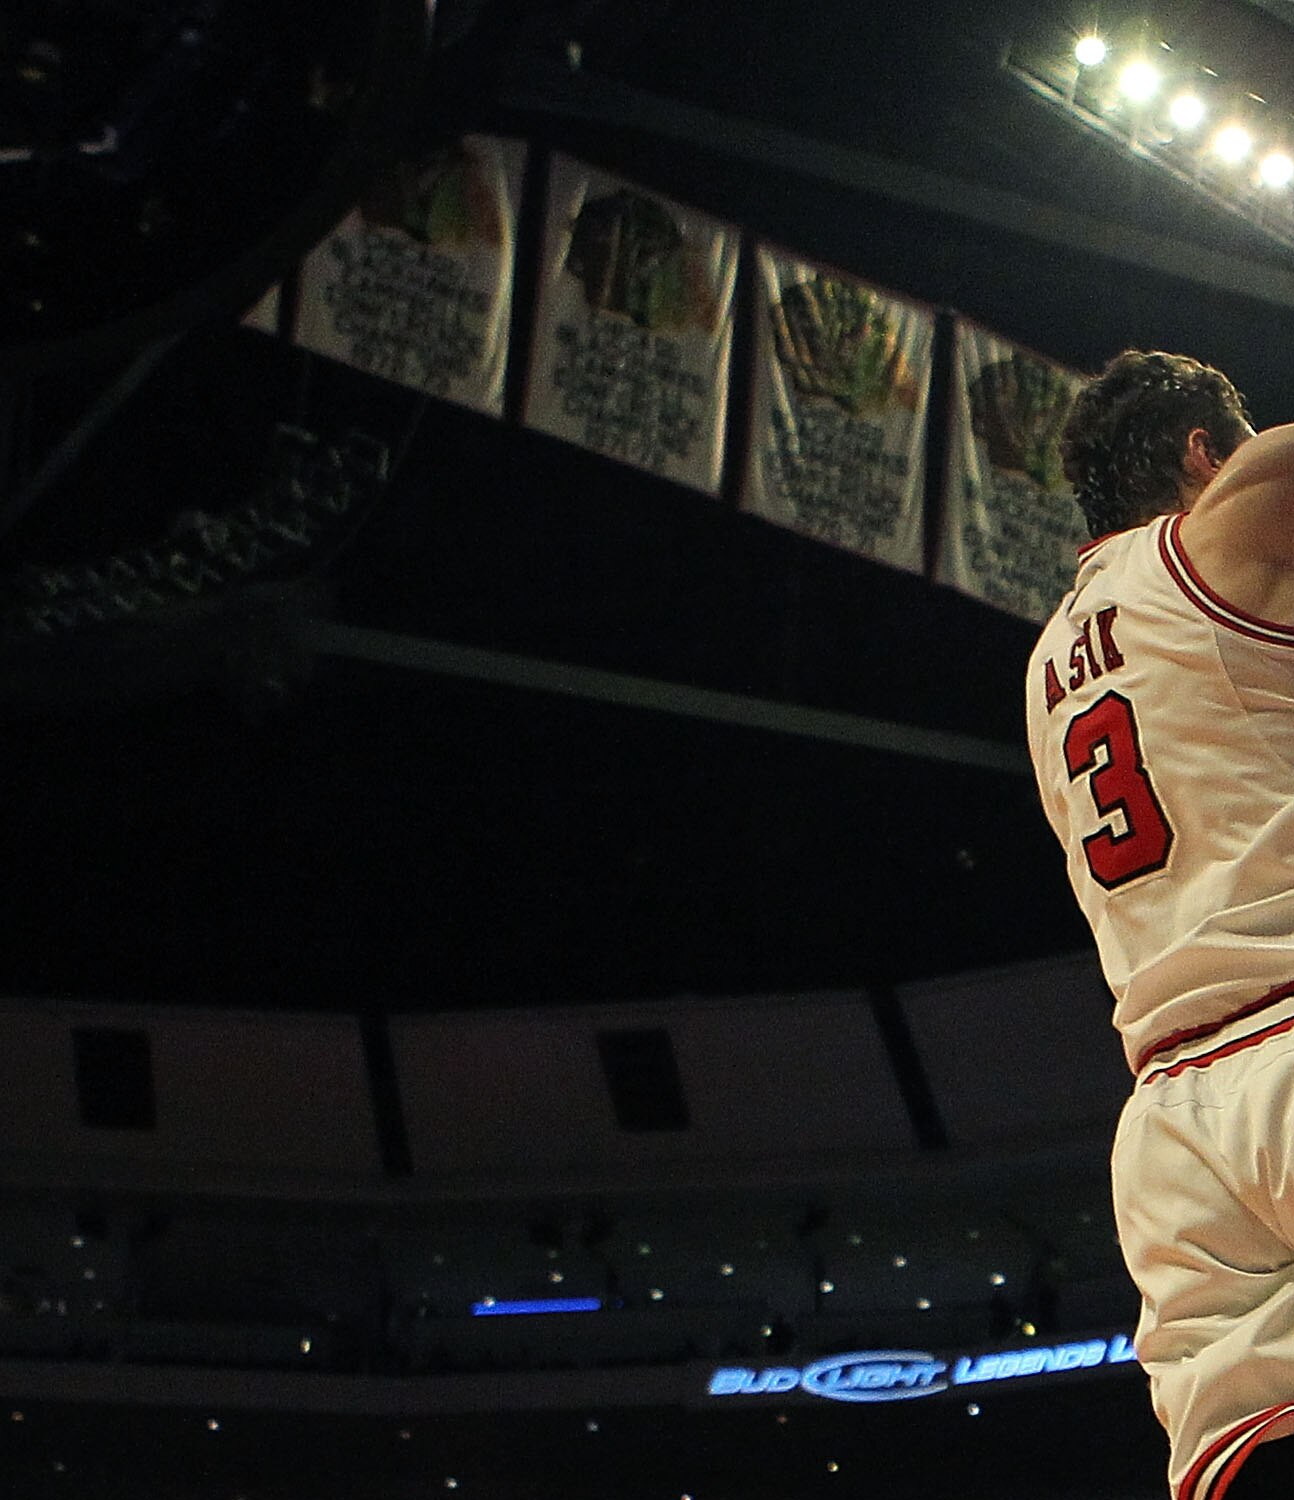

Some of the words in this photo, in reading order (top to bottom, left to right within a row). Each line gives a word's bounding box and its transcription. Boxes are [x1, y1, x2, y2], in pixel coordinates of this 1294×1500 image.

[1045, 605, 1125, 715] ASIK
[1063, 689, 1175, 892] 3
[707, 1366, 801, 1395] BUD
[826, 1360, 947, 1389] LIGHT
[953, 1339, 1108, 1385] LEGENDS
[1107, 1333, 1138, 1363] L
